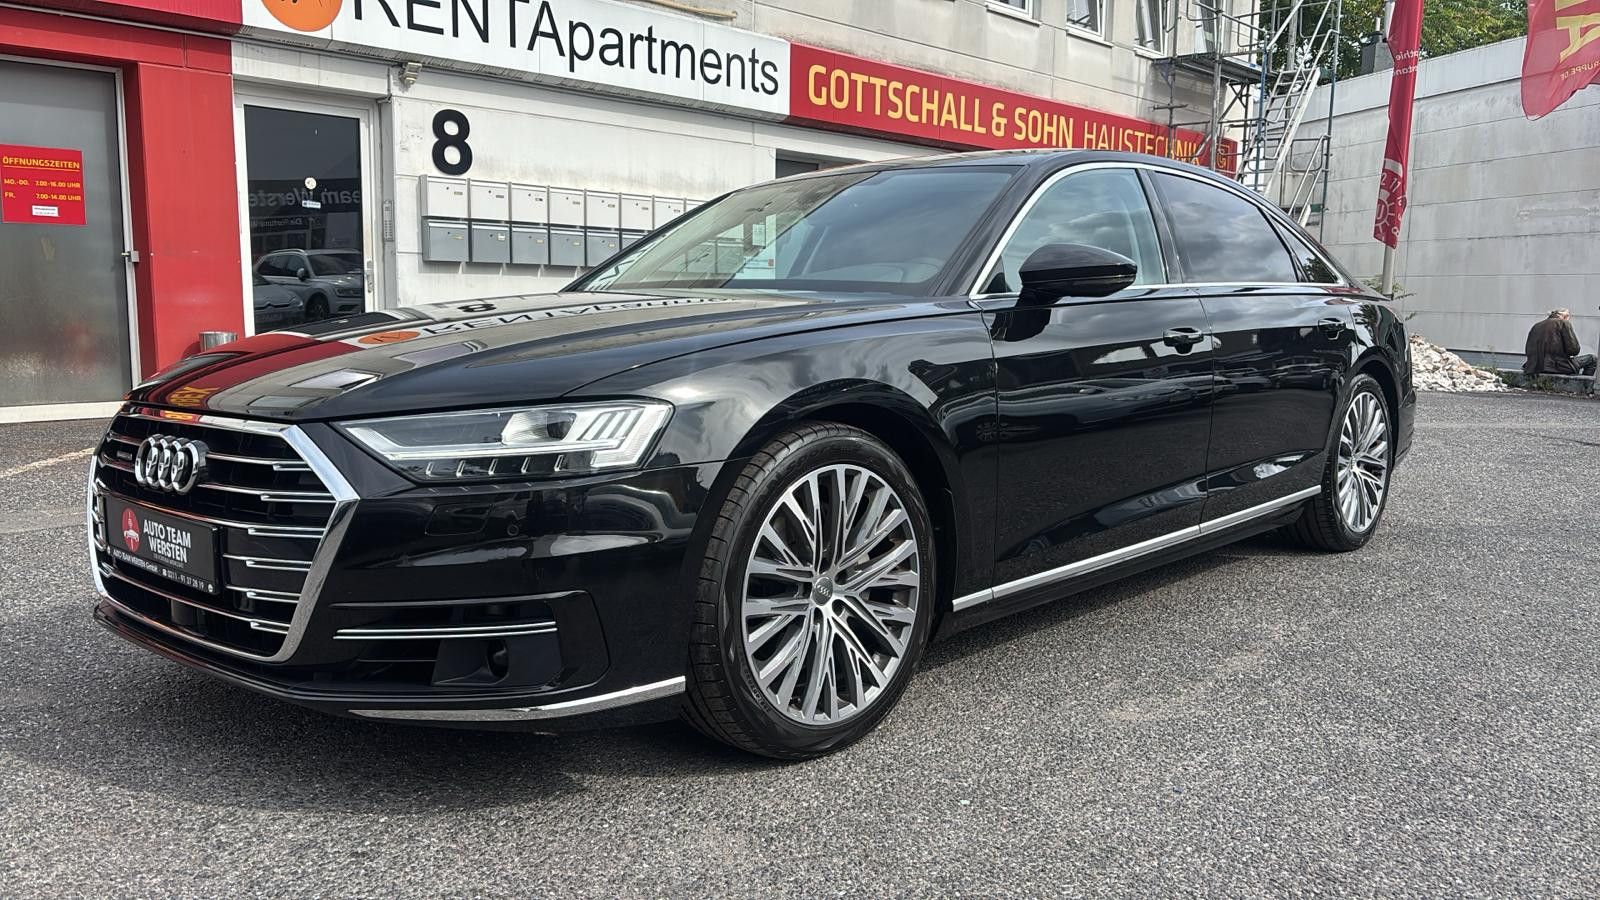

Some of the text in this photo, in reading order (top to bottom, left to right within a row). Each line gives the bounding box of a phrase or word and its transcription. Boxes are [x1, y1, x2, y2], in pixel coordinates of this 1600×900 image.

[808, 64, 987, 134] GOTTSCHALL
[991, 102, 1008, 137] &
[1013, 107, 1074, 148] SOHN
[432, 109, 473, 175] 8
[2, 156, 80, 169] ÖFFNUNGSZEITEN
[143, 519, 192, 548] AUTO TEAM
[148, 535, 188, 563] WERSTEN
